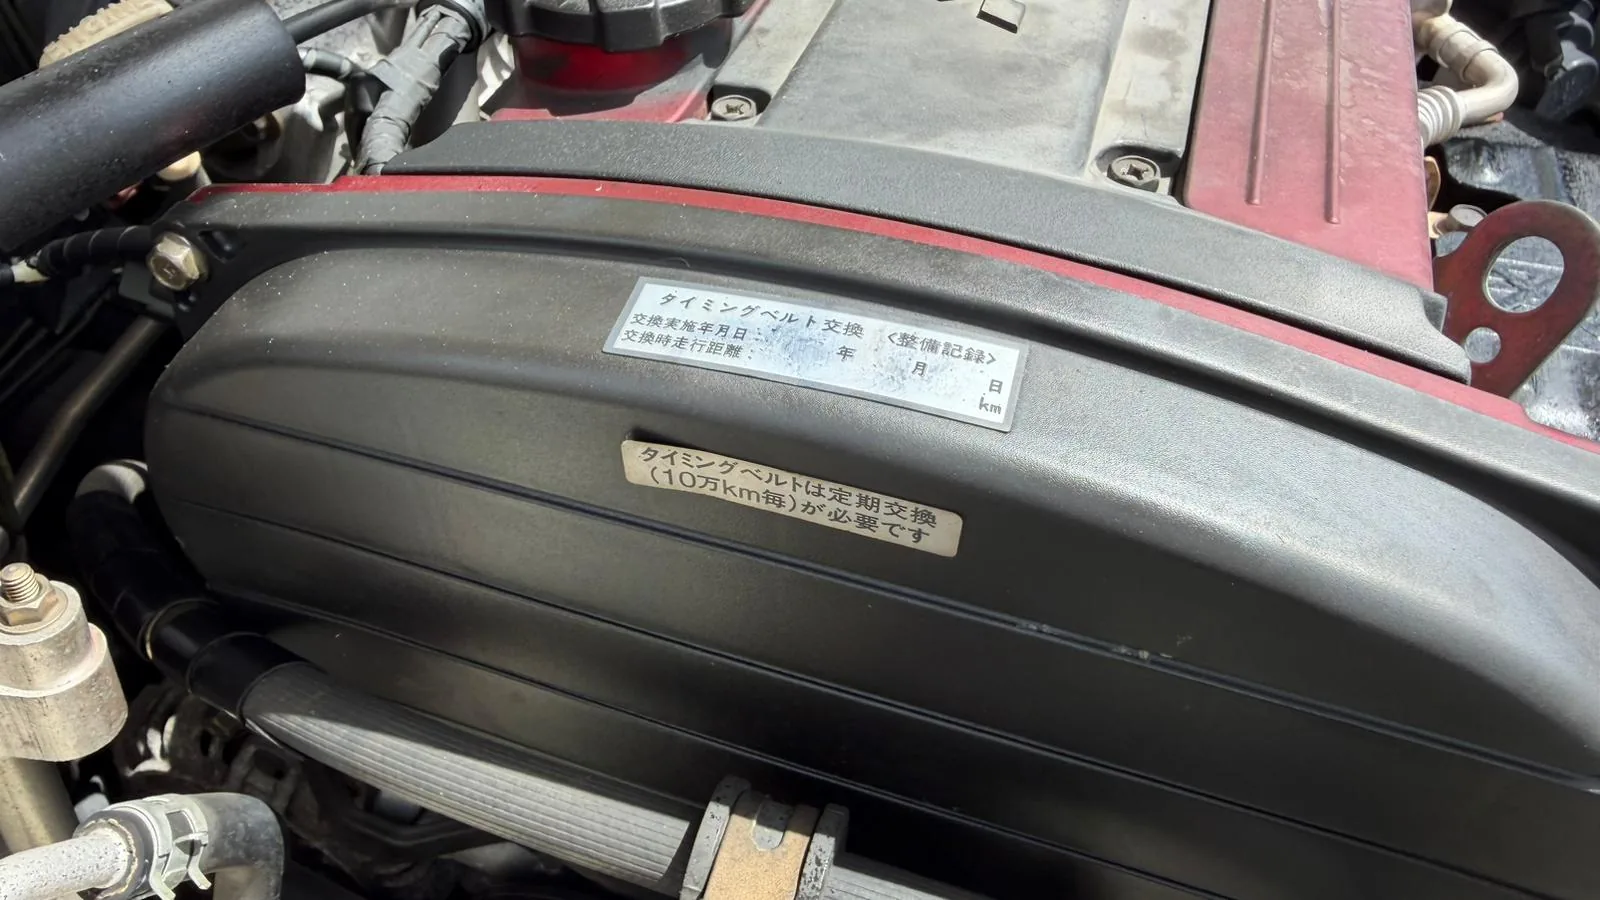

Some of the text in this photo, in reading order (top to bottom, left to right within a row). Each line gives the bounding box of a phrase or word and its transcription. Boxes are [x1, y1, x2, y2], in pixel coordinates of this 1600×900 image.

[660, 292, 864, 339] タイミングベルト交換
[836, 345, 857, 362] 年
[912, 361, 928, 377] 月
[988, 379, 1003, 395] 日
[979, 396, 1002, 415] km
[639, 446, 937, 529] タイミングベルトは定期交換
[650, 465, 930, 544] (10万km毎)が必要です
